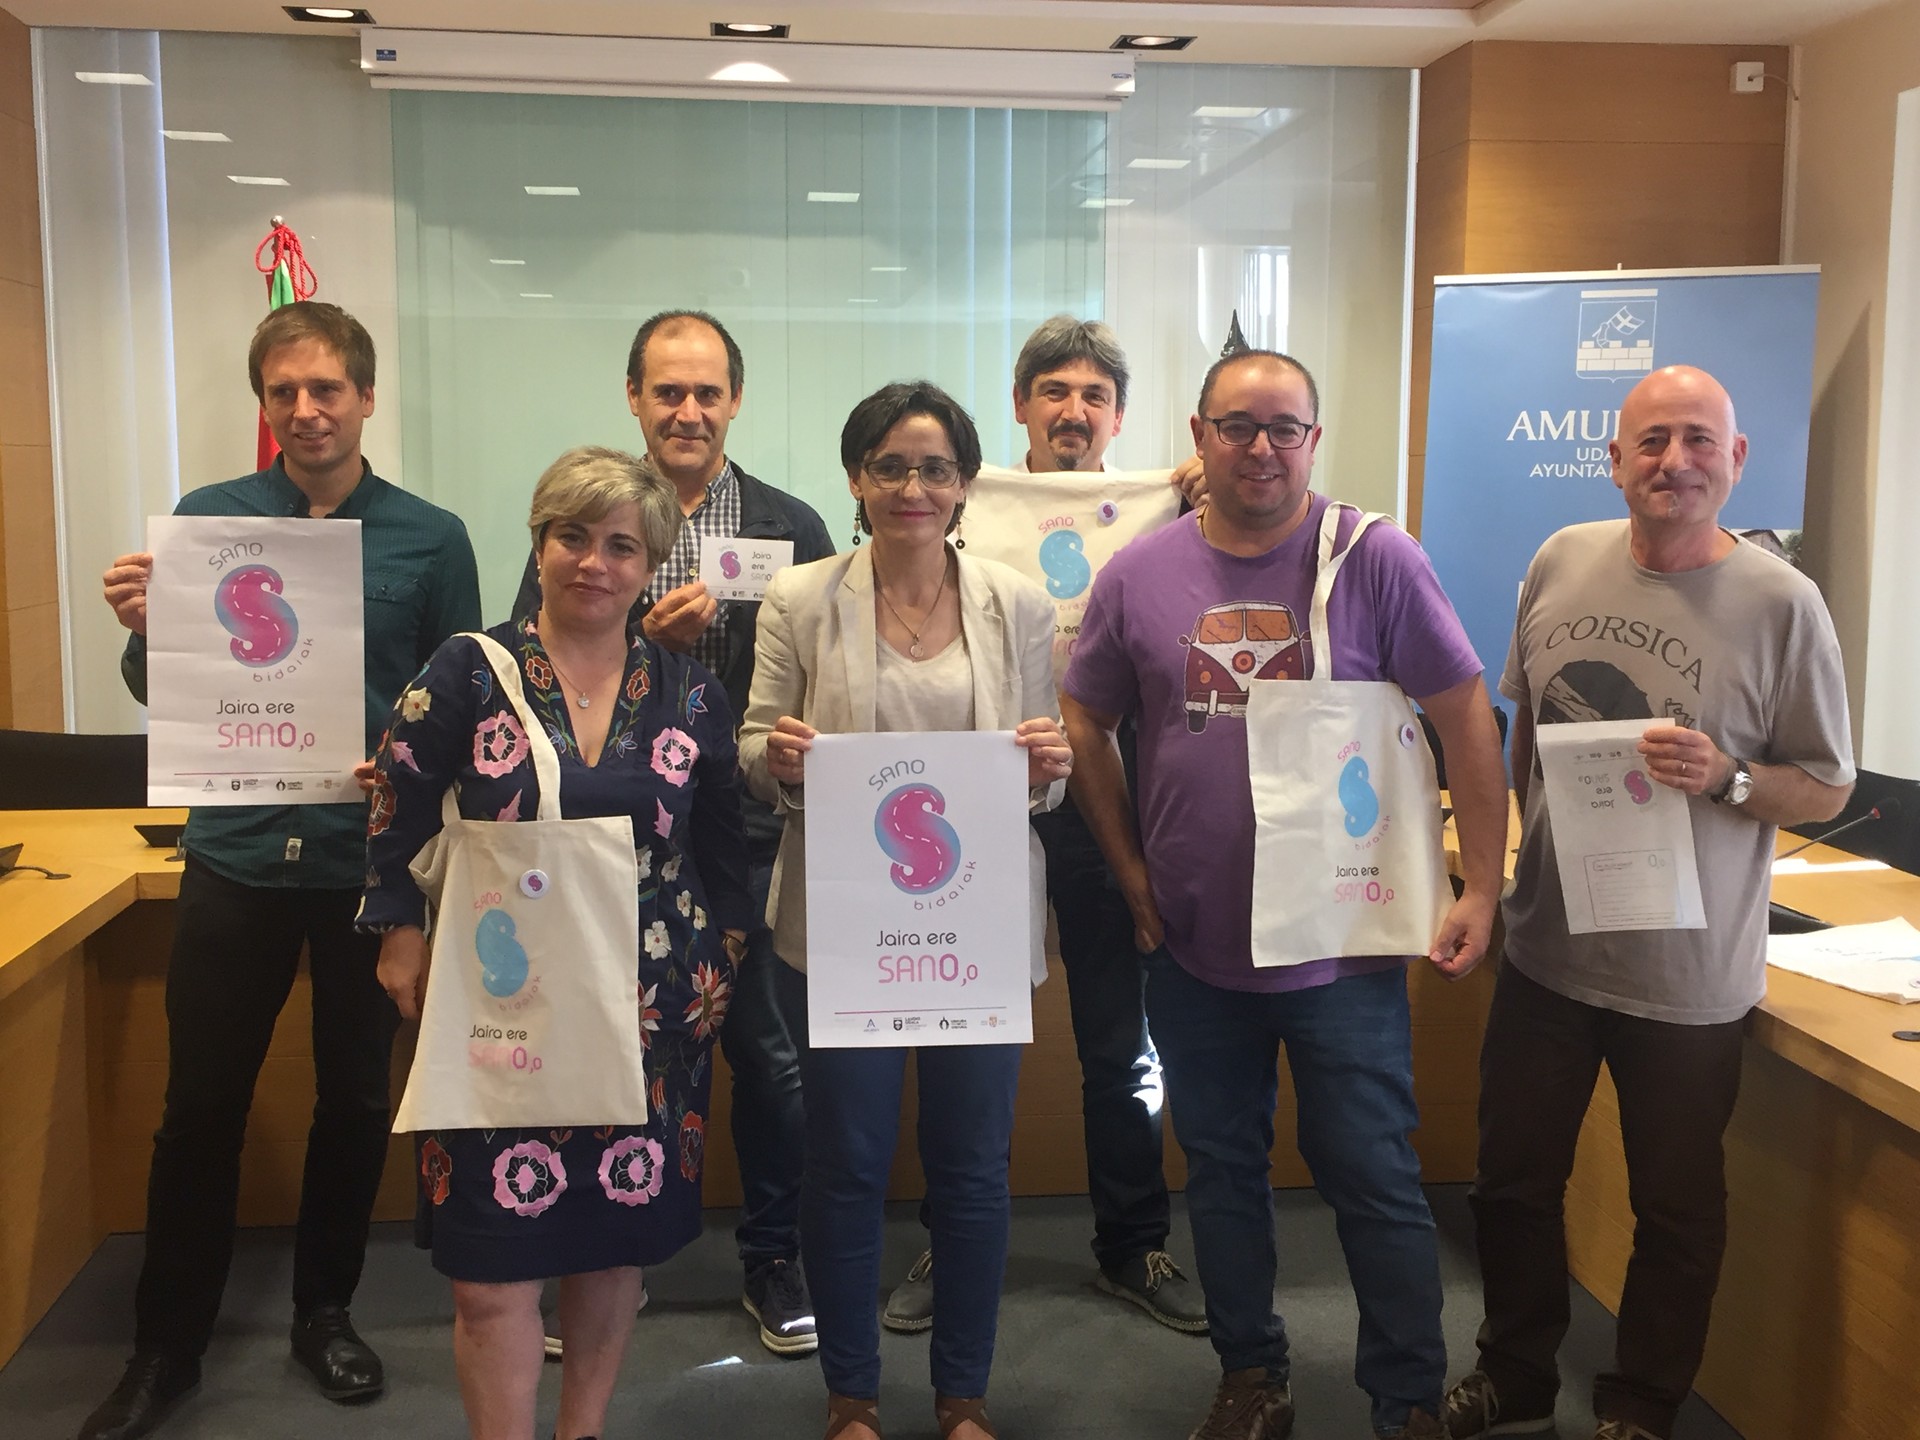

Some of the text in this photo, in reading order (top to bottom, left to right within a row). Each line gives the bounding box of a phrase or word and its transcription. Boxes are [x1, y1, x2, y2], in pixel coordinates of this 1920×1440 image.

[1576, 447, 1612, 461] UDA
[1529, 463, 1613, 478] AYUNTA
[1038, 516, 1074, 534] SANO
[208, 542, 263, 571] SANO
[751, 552, 772, 560] Jaira
[253, 637, 314, 683] bidaiak
[1546, 615, 1704, 695] CORSICA
[216, 700, 295, 715] Jaira ere
[1337, 741, 1361, 763] SANO
[869, 759, 926, 791] SANO
[1335, 865, 1380, 878] Jaira ere
[914, 860, 978, 911] bidaiak
[474, 892, 503, 914] SANO
[877, 930, 957, 947] Jaira ere
[470, 1024, 528, 1040] Jaira ere
